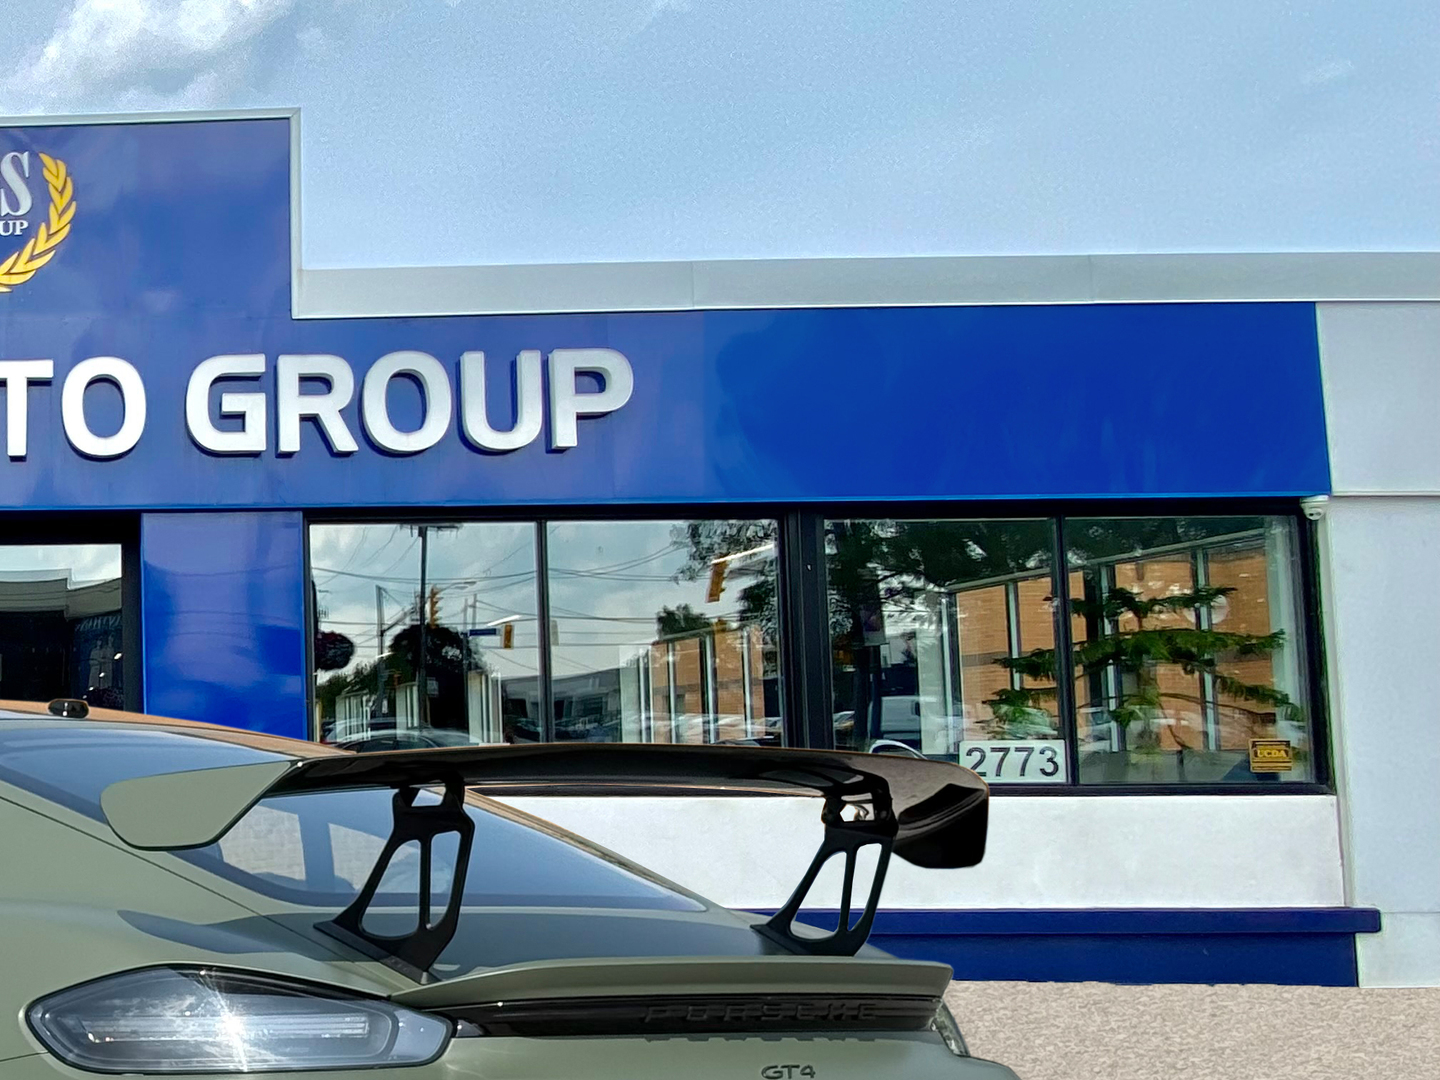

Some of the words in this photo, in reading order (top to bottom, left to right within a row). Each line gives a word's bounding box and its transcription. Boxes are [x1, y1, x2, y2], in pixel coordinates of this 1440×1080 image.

[184, 348, 635, 456] GROUP
[965, 745, 1060, 778] 2773
[644, 1003, 877, 1023] PORSCHE
[761, 1064, 816, 1080] GT4
